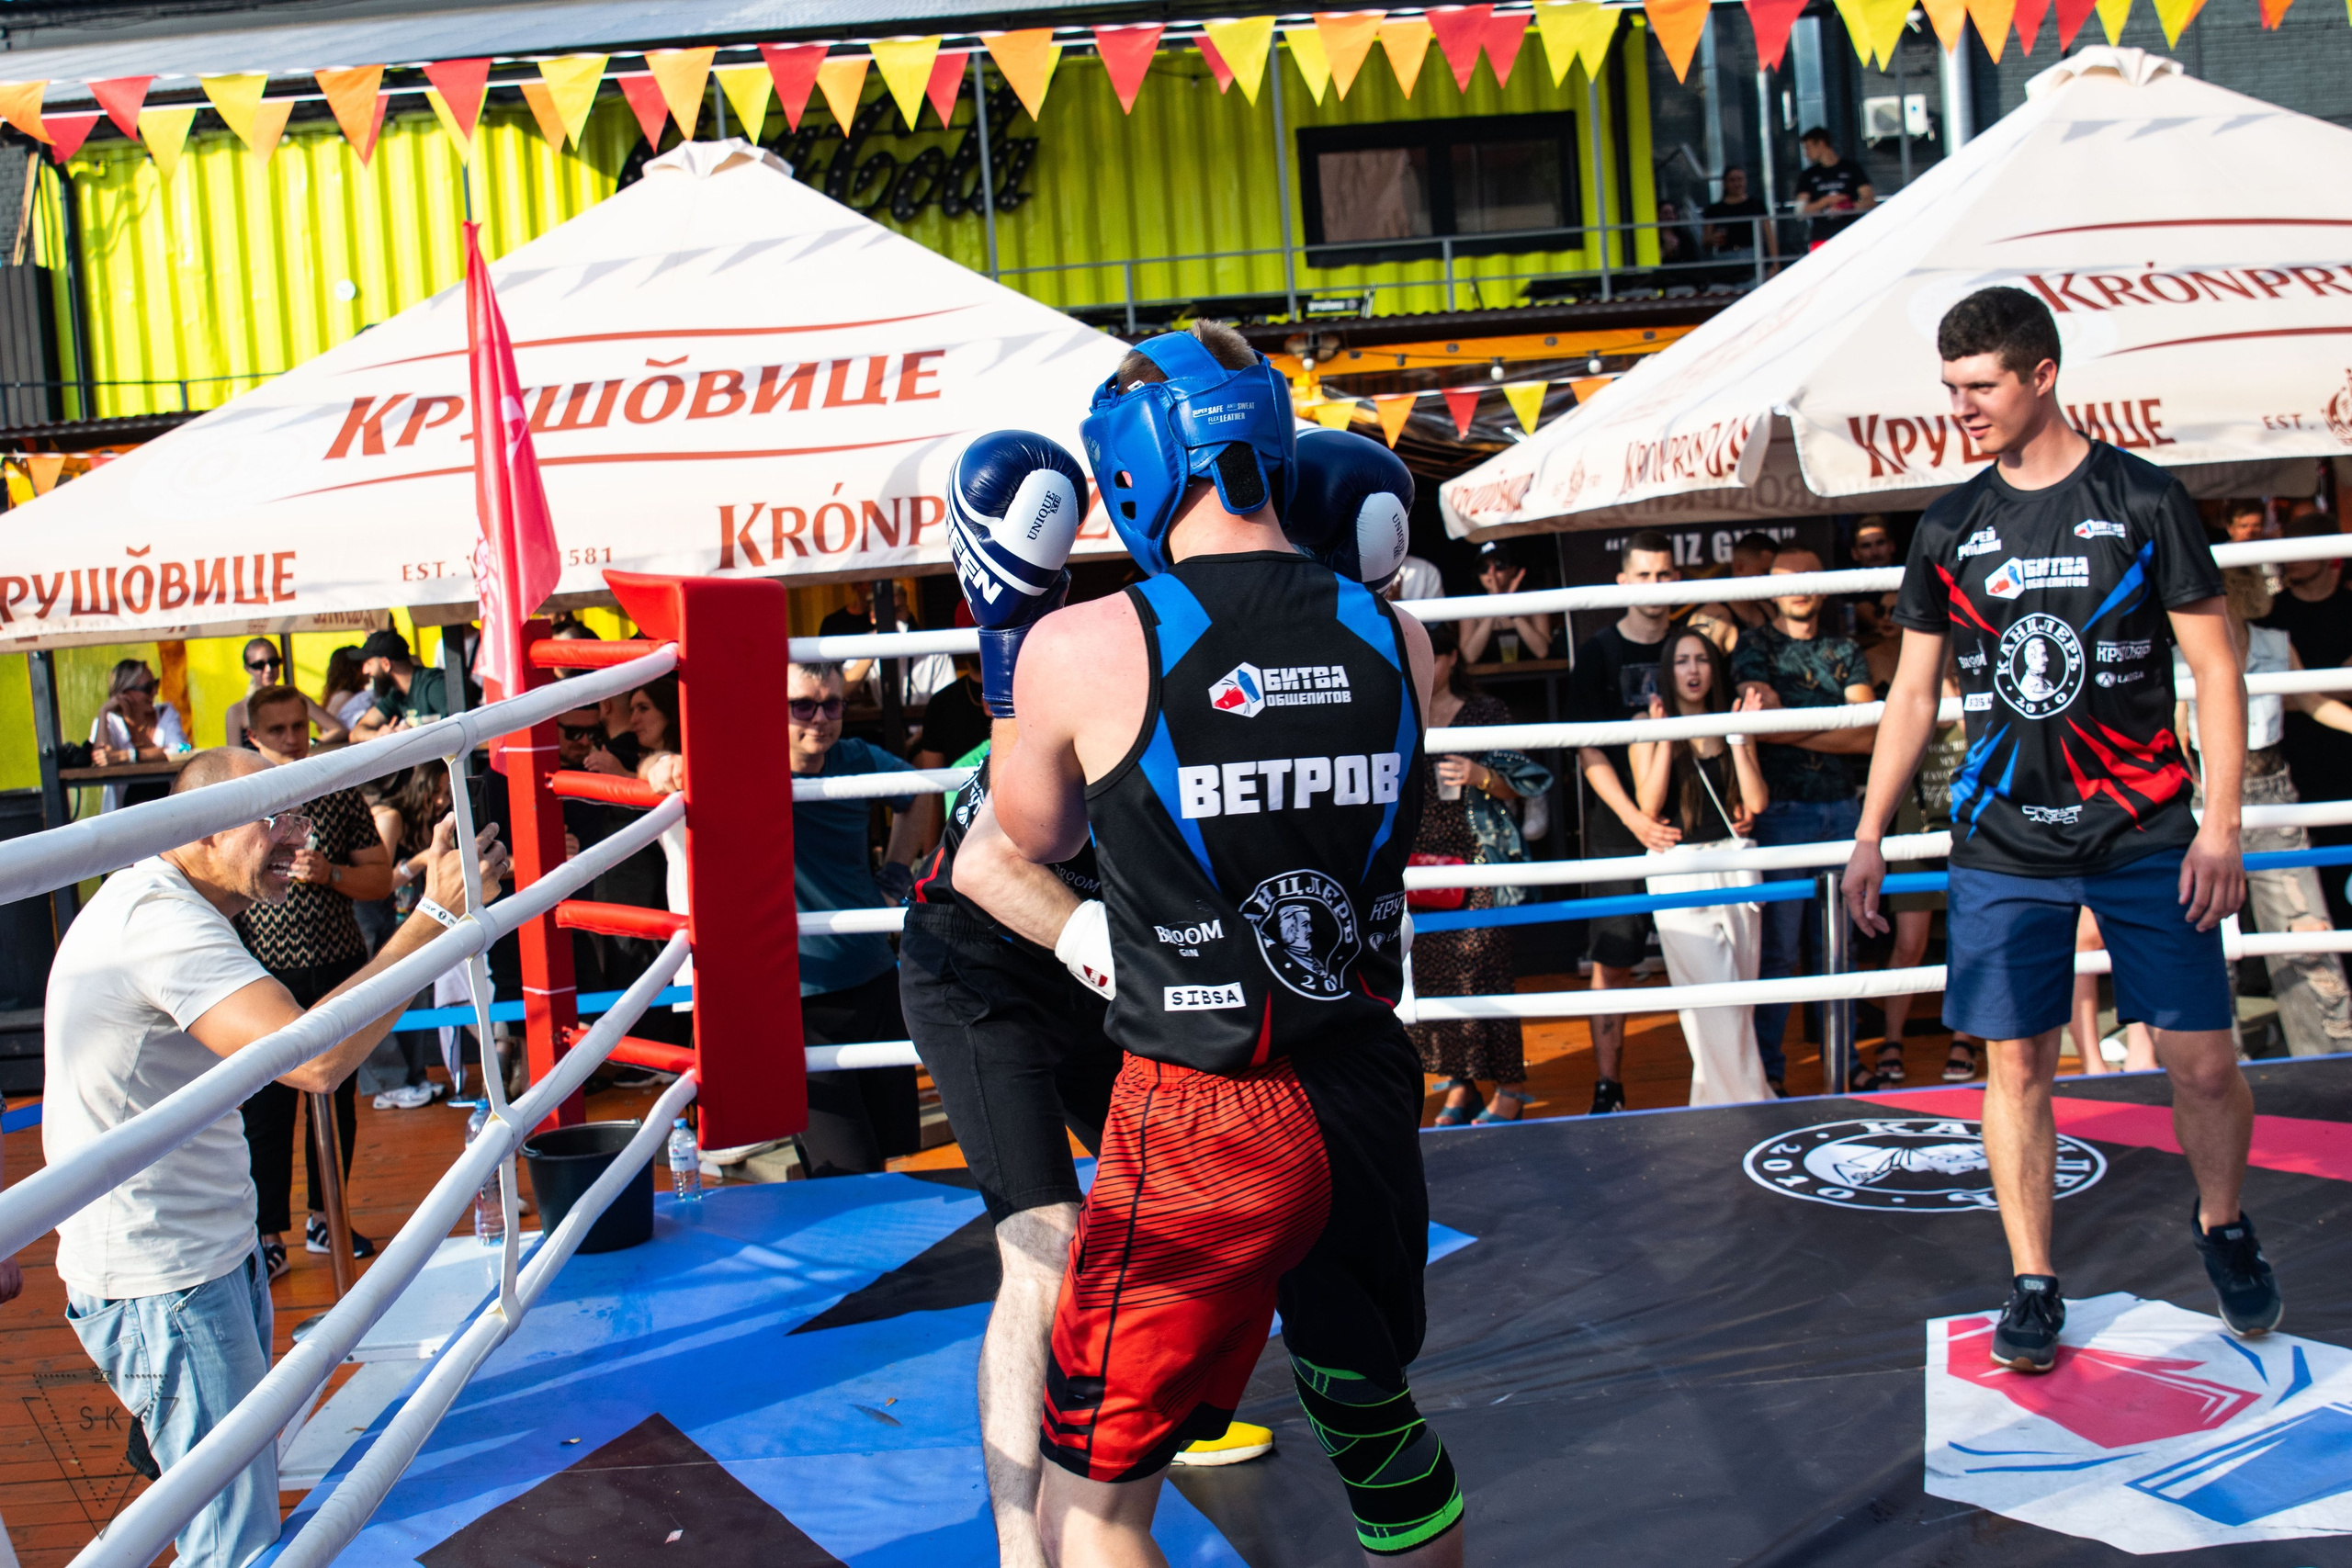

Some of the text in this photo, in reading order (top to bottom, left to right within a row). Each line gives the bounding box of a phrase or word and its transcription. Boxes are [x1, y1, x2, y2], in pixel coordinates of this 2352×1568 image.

[2261, 412, 2314, 431] EST.
[1026, 490, 1056, 540] UNIQUE
[402, 546, 613, 582] EST. 581
[1996, 618, 2081, 676] КАНЦЛЕРЪ
[1262, 666, 1350, 692] БИТВА
[2015, 692, 2067, 714] 2010
[1177, 751, 1401, 819] ВЕТРОВ
[1153, 919, 1225, 946] BROOM
[1178, 948, 1200, 957] GIN
[1171, 988, 1239, 1006] SIBSA
